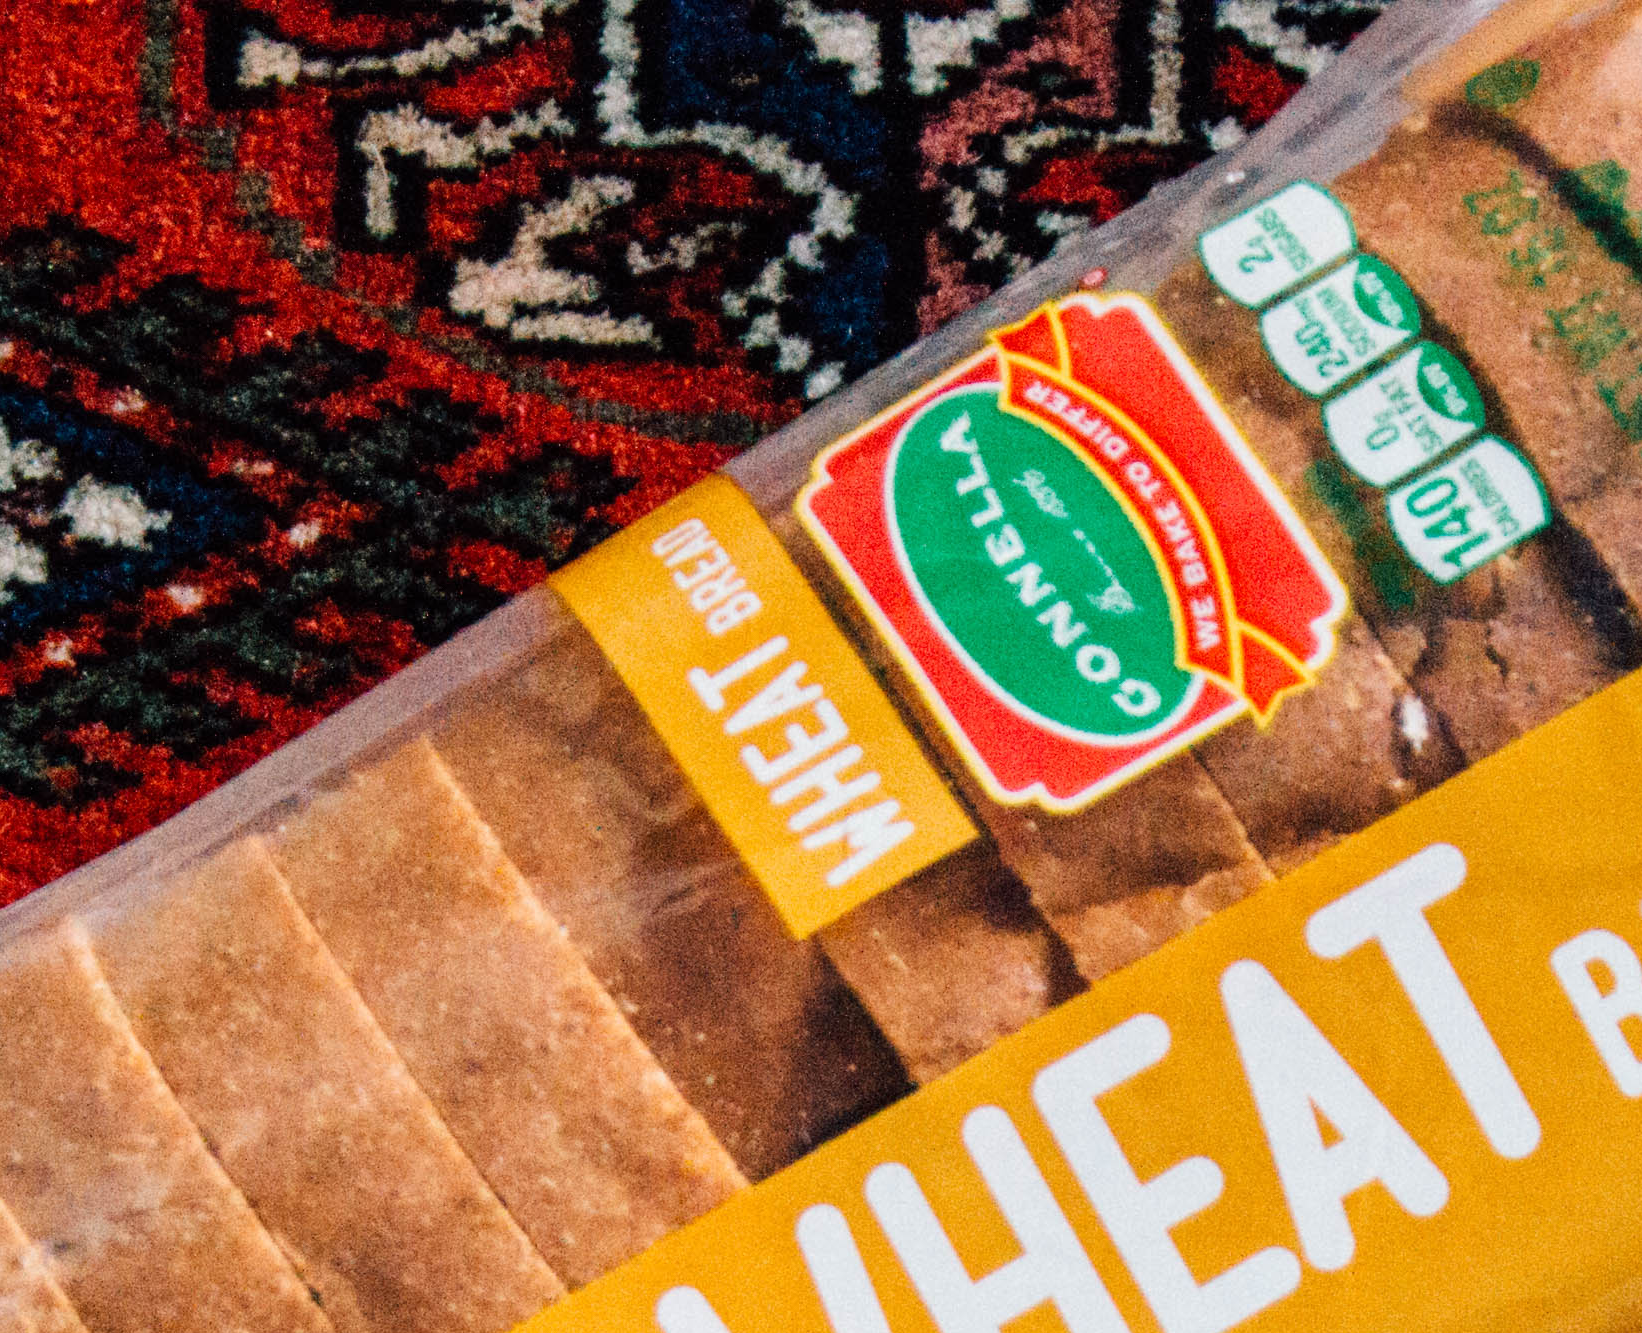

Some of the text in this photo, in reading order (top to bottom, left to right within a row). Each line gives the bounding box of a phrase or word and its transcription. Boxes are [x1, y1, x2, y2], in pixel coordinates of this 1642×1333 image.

[1254, 203, 1315, 276] SUGARS
[1314, 282, 1379, 360] SODIUM
[1377, 376, 1447, 457] SAT FAT
[939, 411, 1163, 719] GONNELLA
[1023, 381, 1221, 651] WE BAKE TO DIFFER
[1401, 471, 1494, 574] 140
[651, 518, 916, 888] WHEAT BREAD
